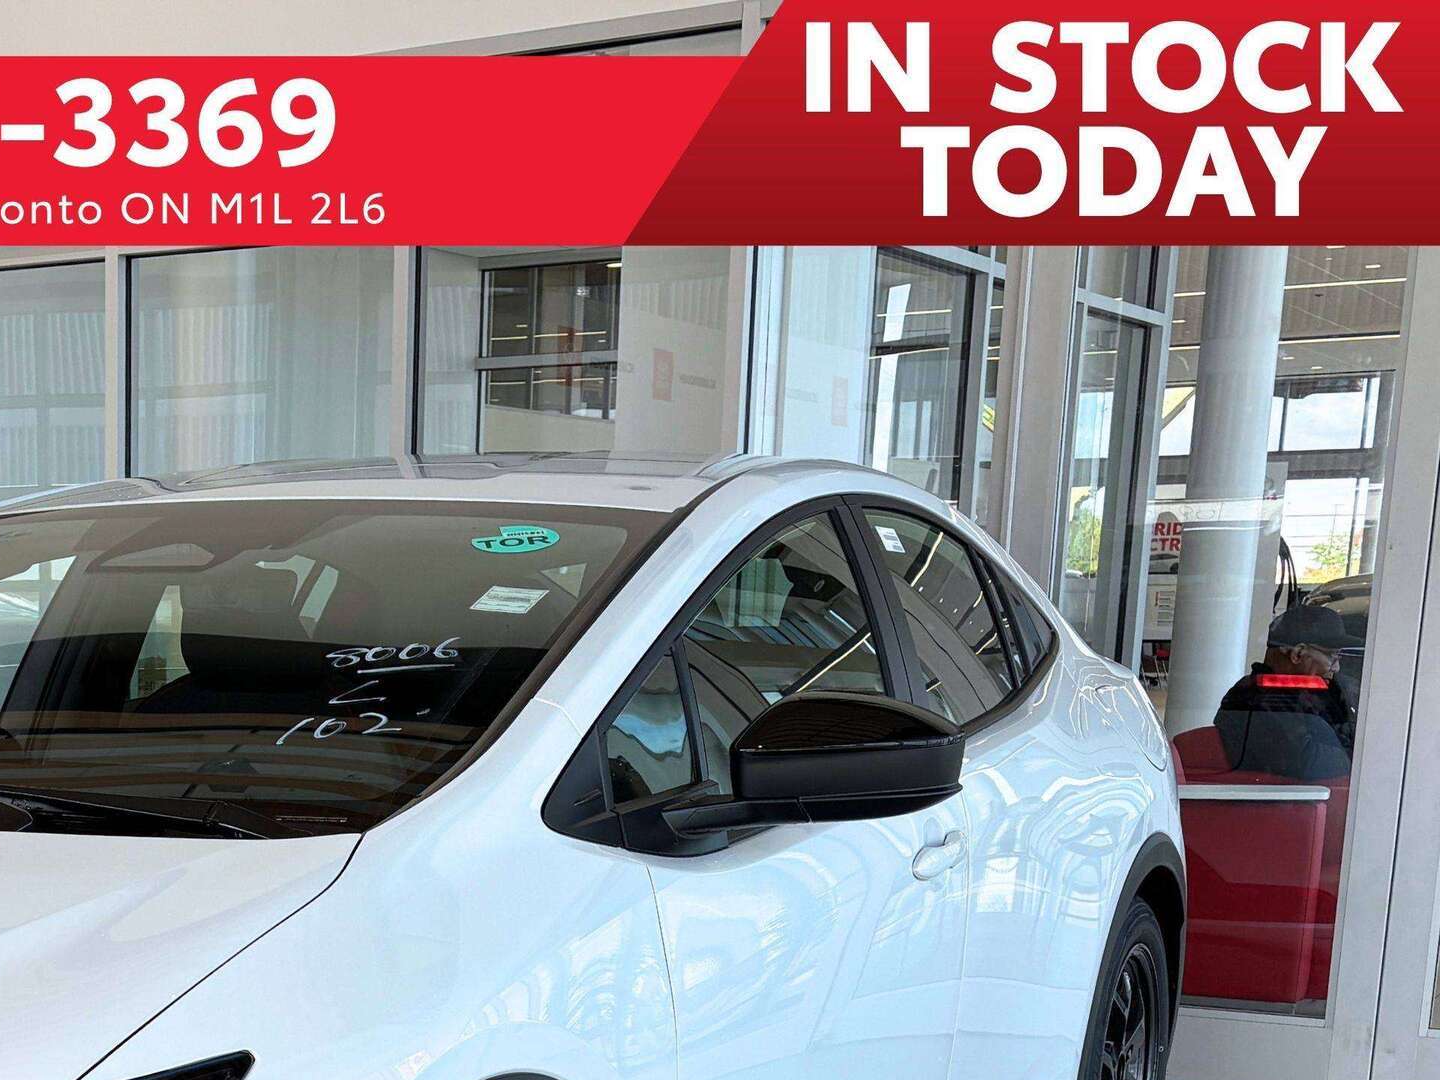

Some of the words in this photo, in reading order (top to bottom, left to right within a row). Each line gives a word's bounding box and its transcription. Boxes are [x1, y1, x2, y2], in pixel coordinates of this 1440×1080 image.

[1152, 522, 1182, 536] RID
[477, 535, 551, 549] TOR
[325, 637, 460, 668] 8006
